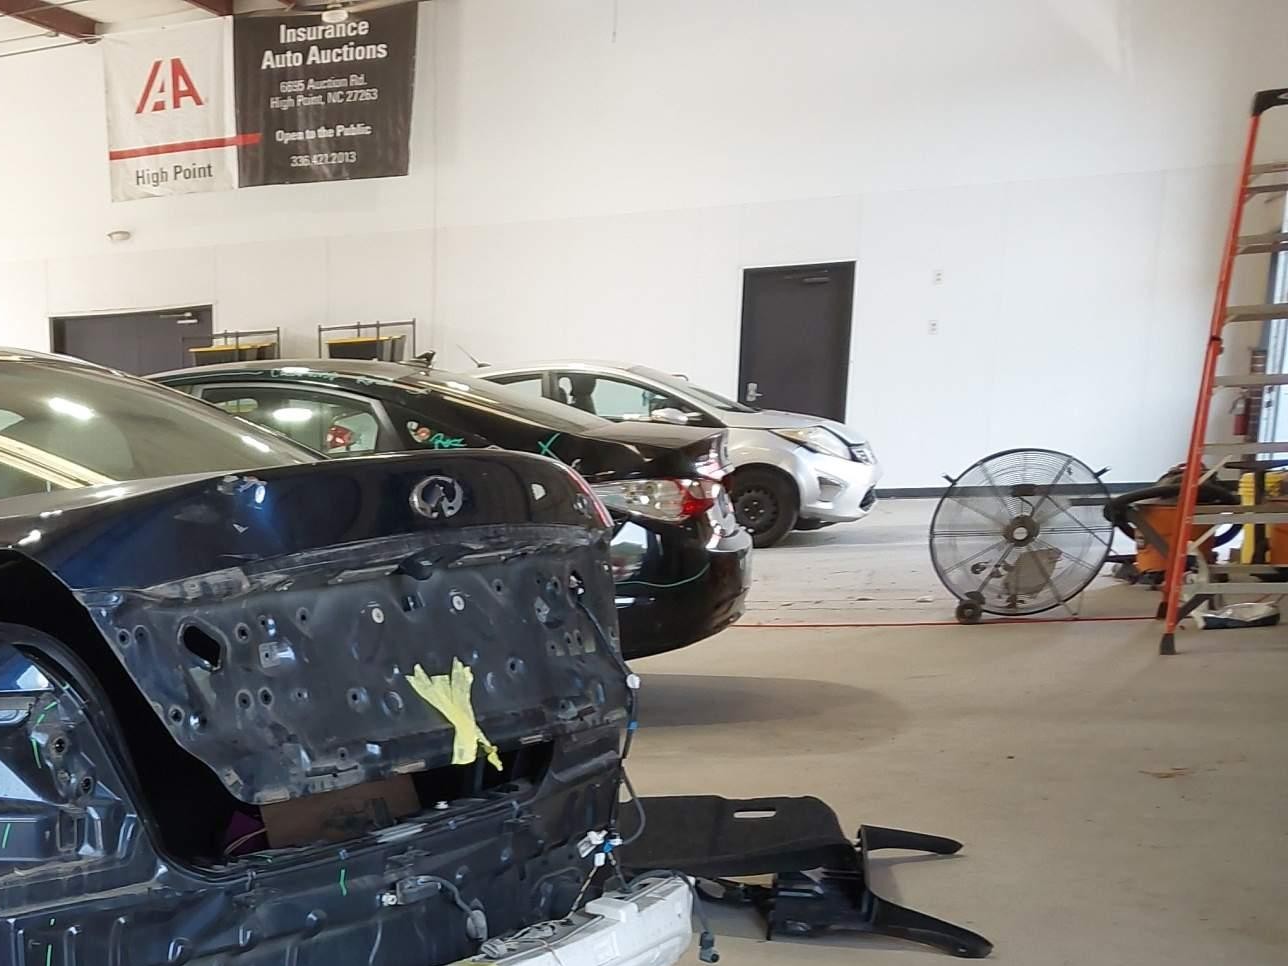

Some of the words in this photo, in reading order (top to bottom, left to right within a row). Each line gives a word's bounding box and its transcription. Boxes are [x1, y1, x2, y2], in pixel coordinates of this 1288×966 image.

[279, 21, 370, 44] Insurance
[261, 49, 302, 70] Auto
[306, 43, 388, 65] Auctions
[306, 77, 348, 91] Auction
[349, 74, 368, 87] Rd.
[270, 96, 295, 110] High
[296, 93, 325, 107] Point,
[327, 91, 344, 104] NC
[345, 88, 378, 102] 27263
[275, 129, 305, 144] Open
[305, 129, 316, 140] to
[317, 126, 334, 138] the
[335, 123, 373, 137] Public
[136, 169, 169, 188] High
[173, 163, 214, 182] Point
